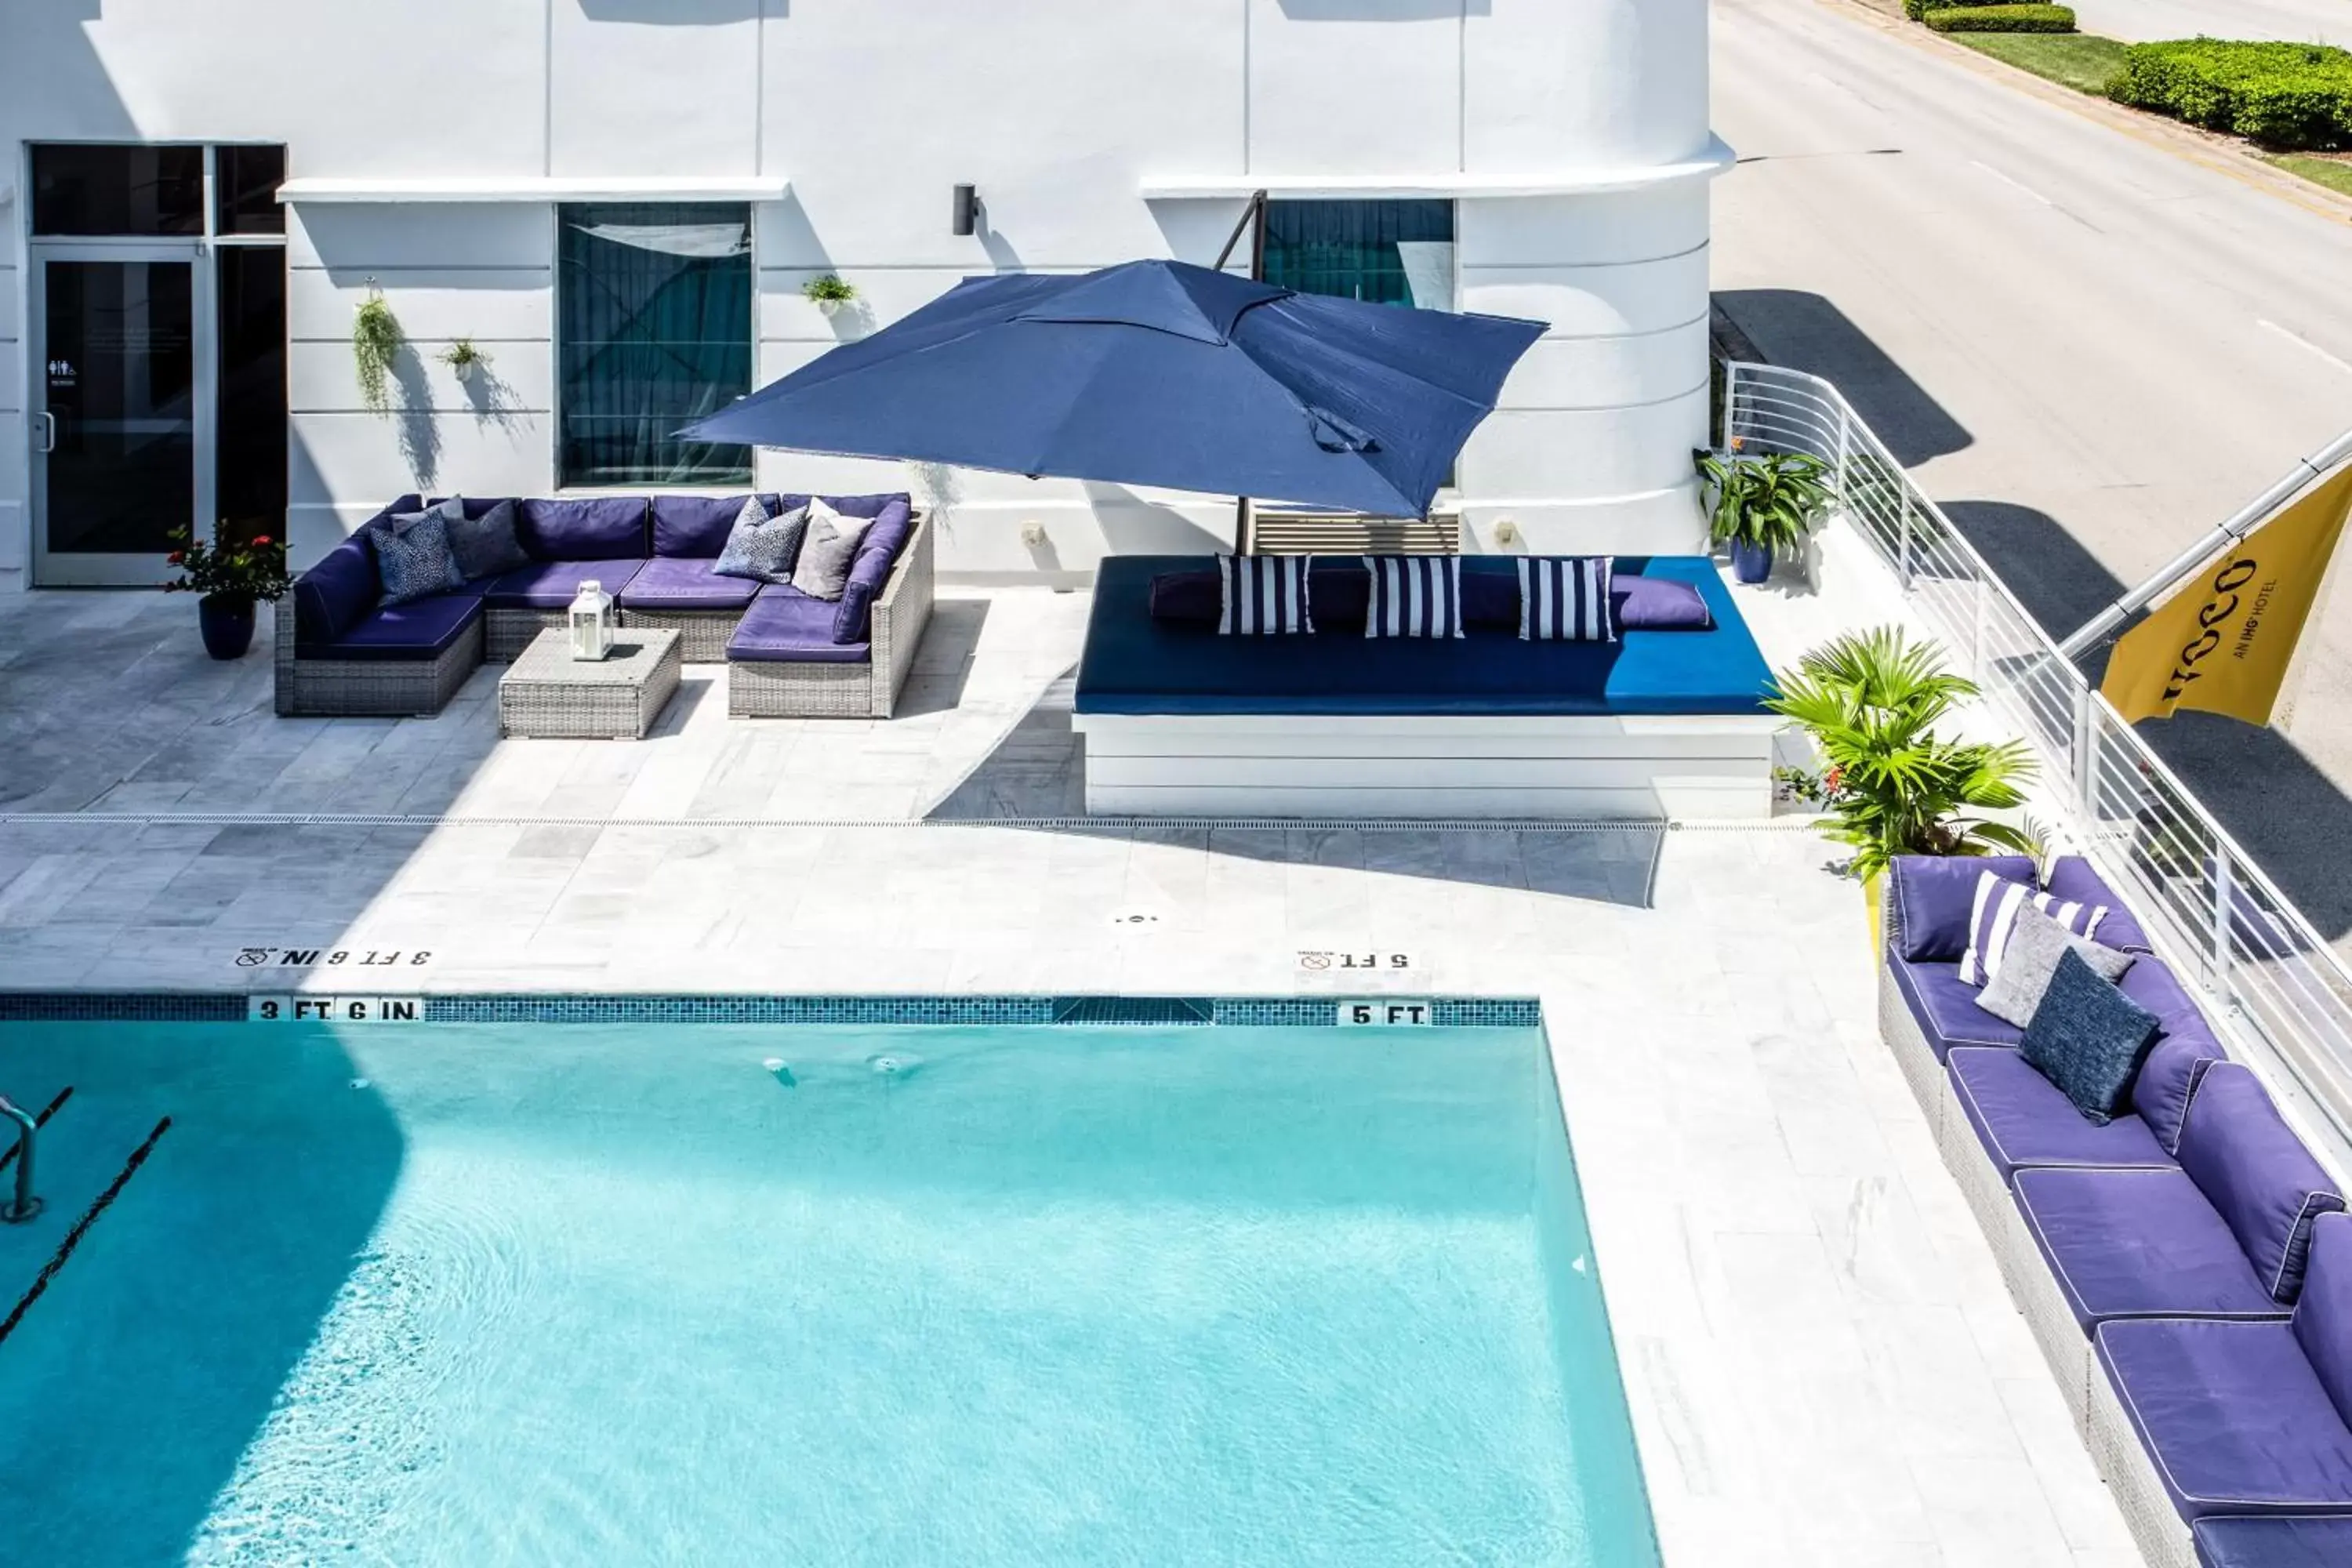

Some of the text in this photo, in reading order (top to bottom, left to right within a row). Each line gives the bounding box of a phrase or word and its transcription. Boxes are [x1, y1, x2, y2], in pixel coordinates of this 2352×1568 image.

[2233, 639, 2249, 659] AN
[2252, 579, 2278, 616] HOTEL
[280, 950, 432, 965] 3 FT. 6 IN.
[1340, 954, 1409, 968] 5 FT.
[260, 1000, 419, 1020] 3 FT. 6 IN.
[1352, 1005, 1425, 1025] 5 FT.
